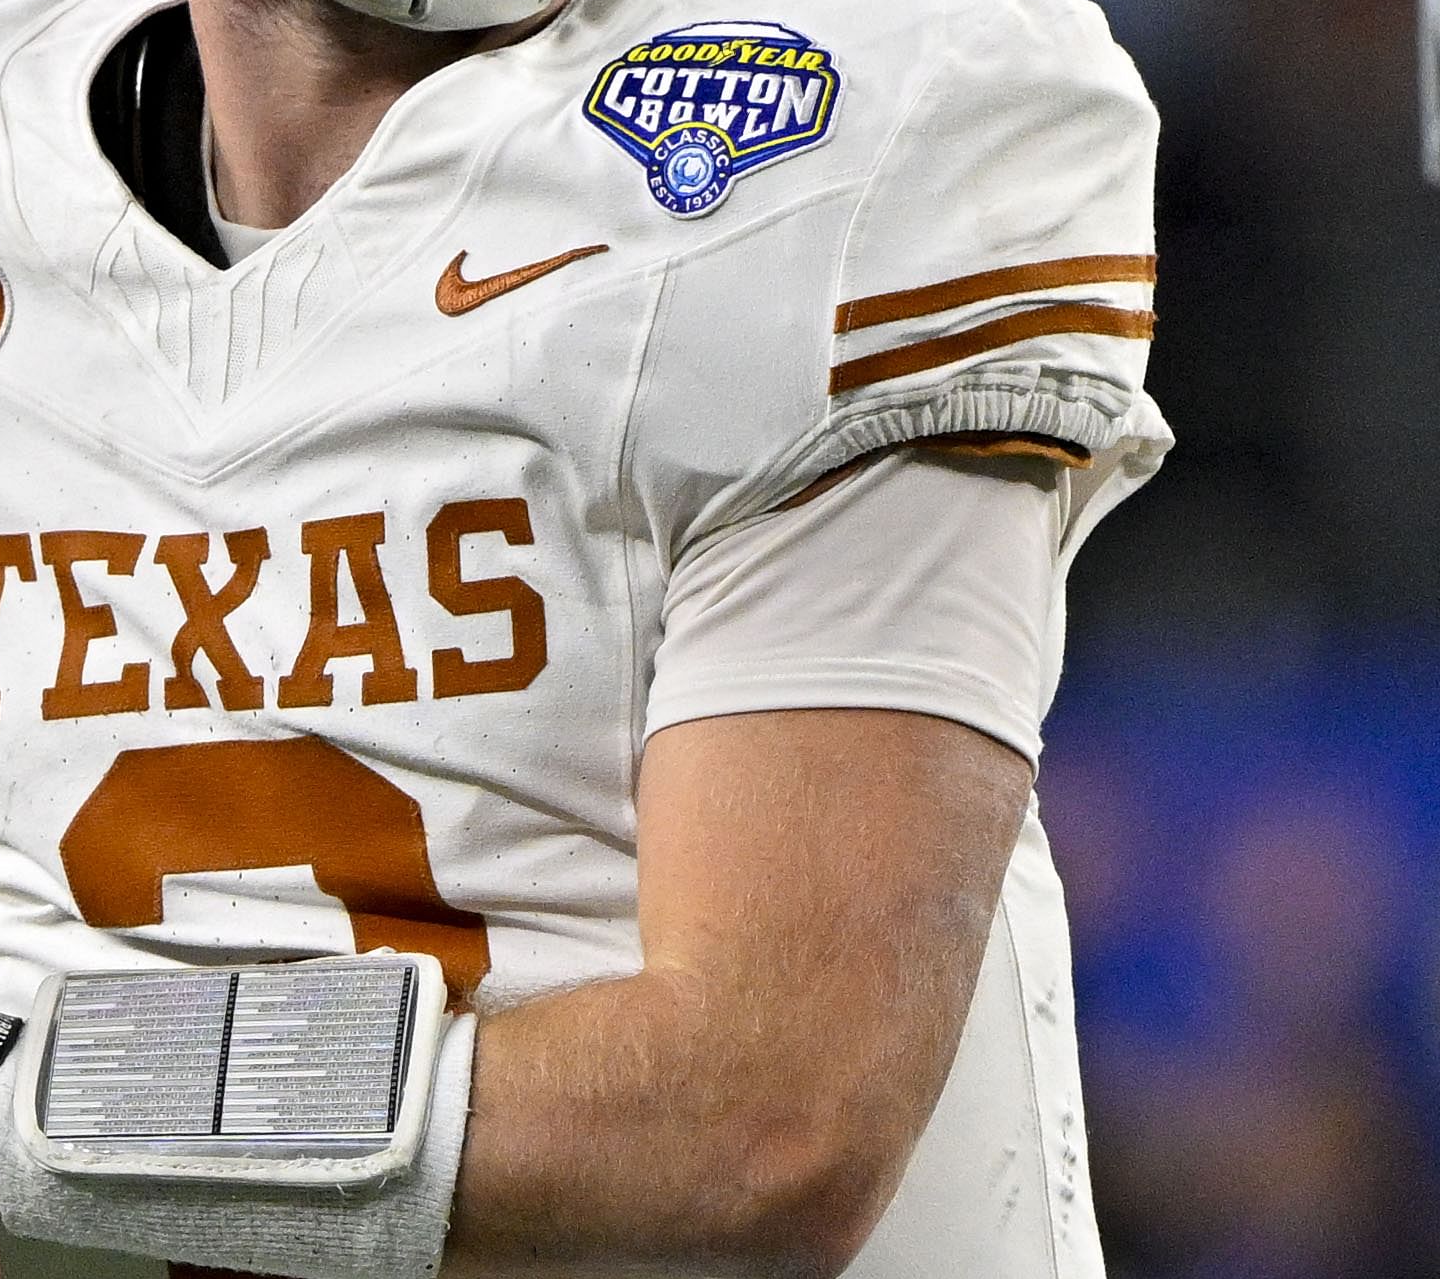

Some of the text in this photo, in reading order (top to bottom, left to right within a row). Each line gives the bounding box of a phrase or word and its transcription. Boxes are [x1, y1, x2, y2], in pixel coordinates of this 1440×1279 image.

[604, 67, 823, 132] COTTON
[634, 98, 771, 142] BOWL
[654, 129, 730, 169] CLASSIC
[684, 184, 721, 211] 1937
